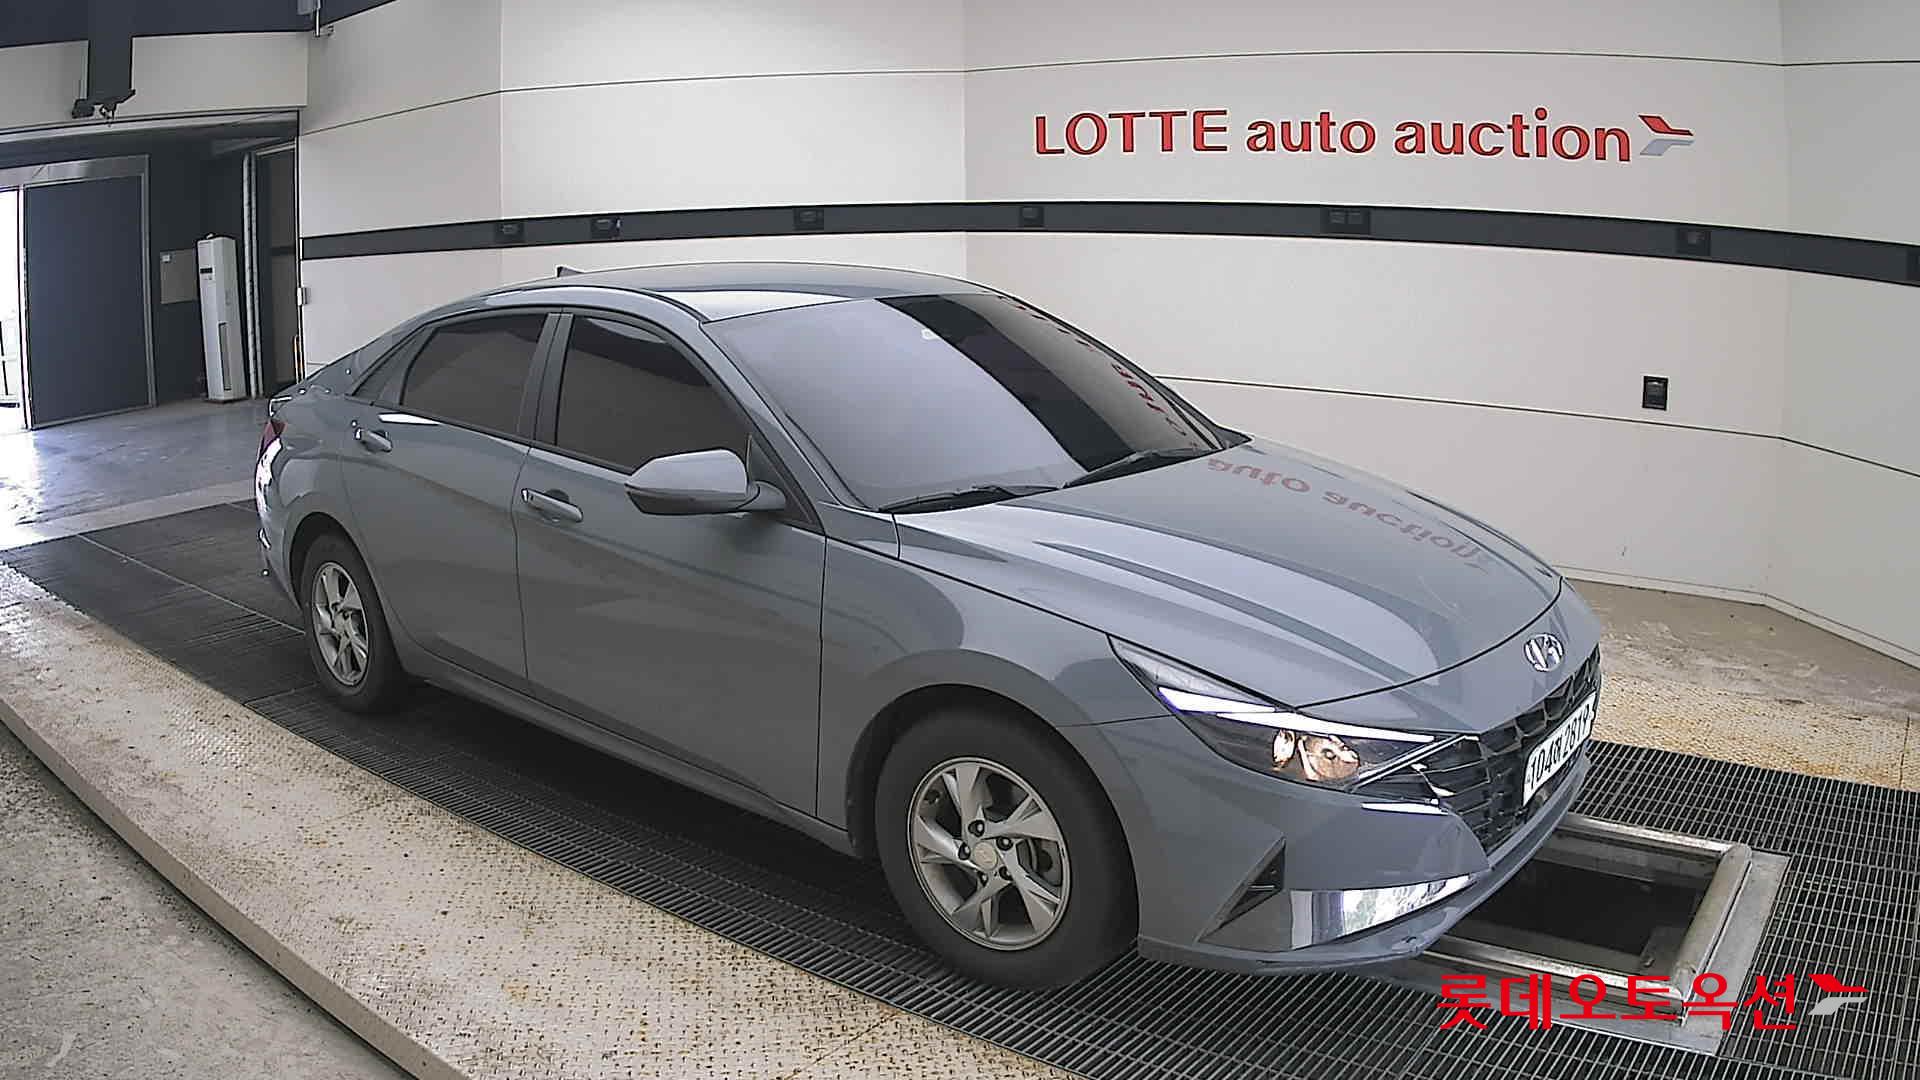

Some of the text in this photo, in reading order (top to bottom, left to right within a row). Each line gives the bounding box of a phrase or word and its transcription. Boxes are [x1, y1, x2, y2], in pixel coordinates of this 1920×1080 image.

[1034, 108, 1632, 163] LOTTE auto auction
